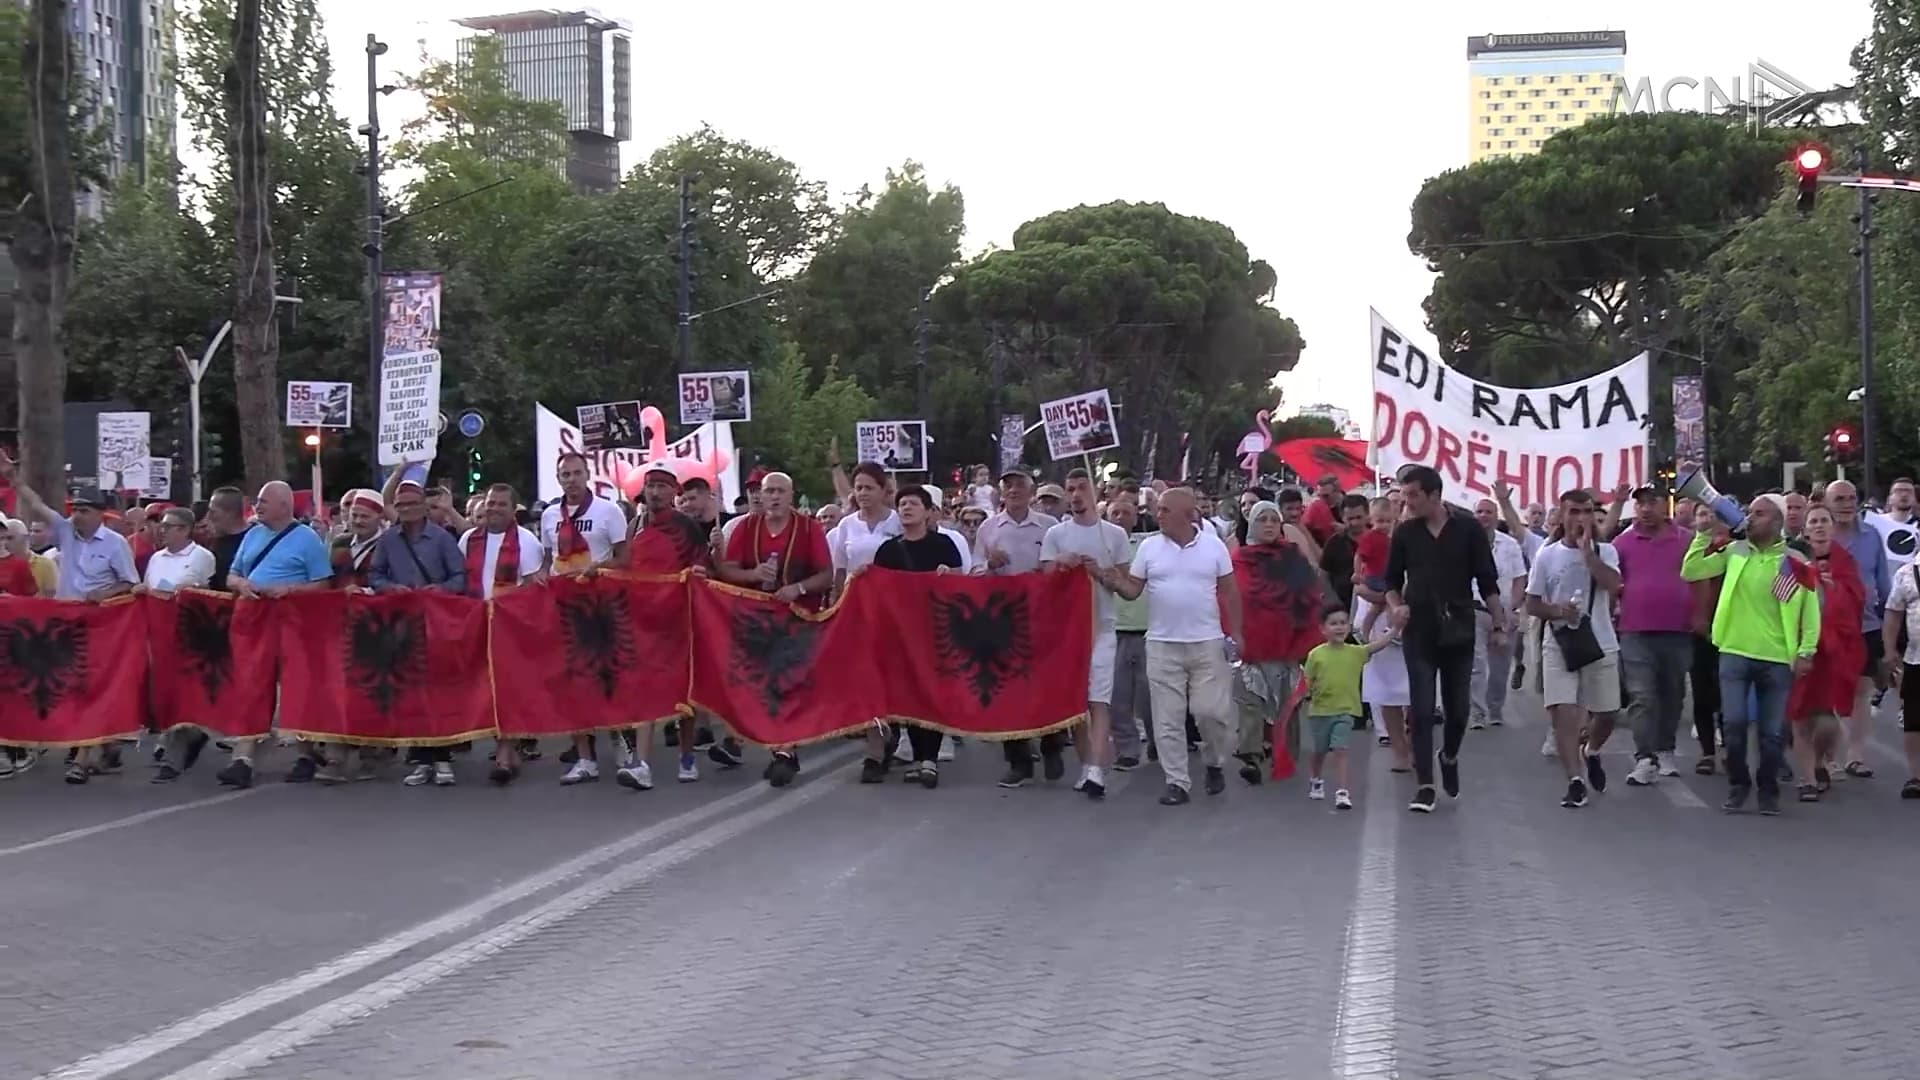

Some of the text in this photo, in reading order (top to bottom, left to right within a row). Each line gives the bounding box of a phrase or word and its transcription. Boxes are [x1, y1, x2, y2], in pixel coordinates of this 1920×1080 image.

[1376, 326, 1650, 430] EDI RAMA,
[291, 384, 311, 401] 55
[682, 377, 709, 402] 55
[1044, 399, 1091, 430] DAY 55
[860, 425, 896, 443] DAY 55
[391, 440, 424, 454] SPAK
